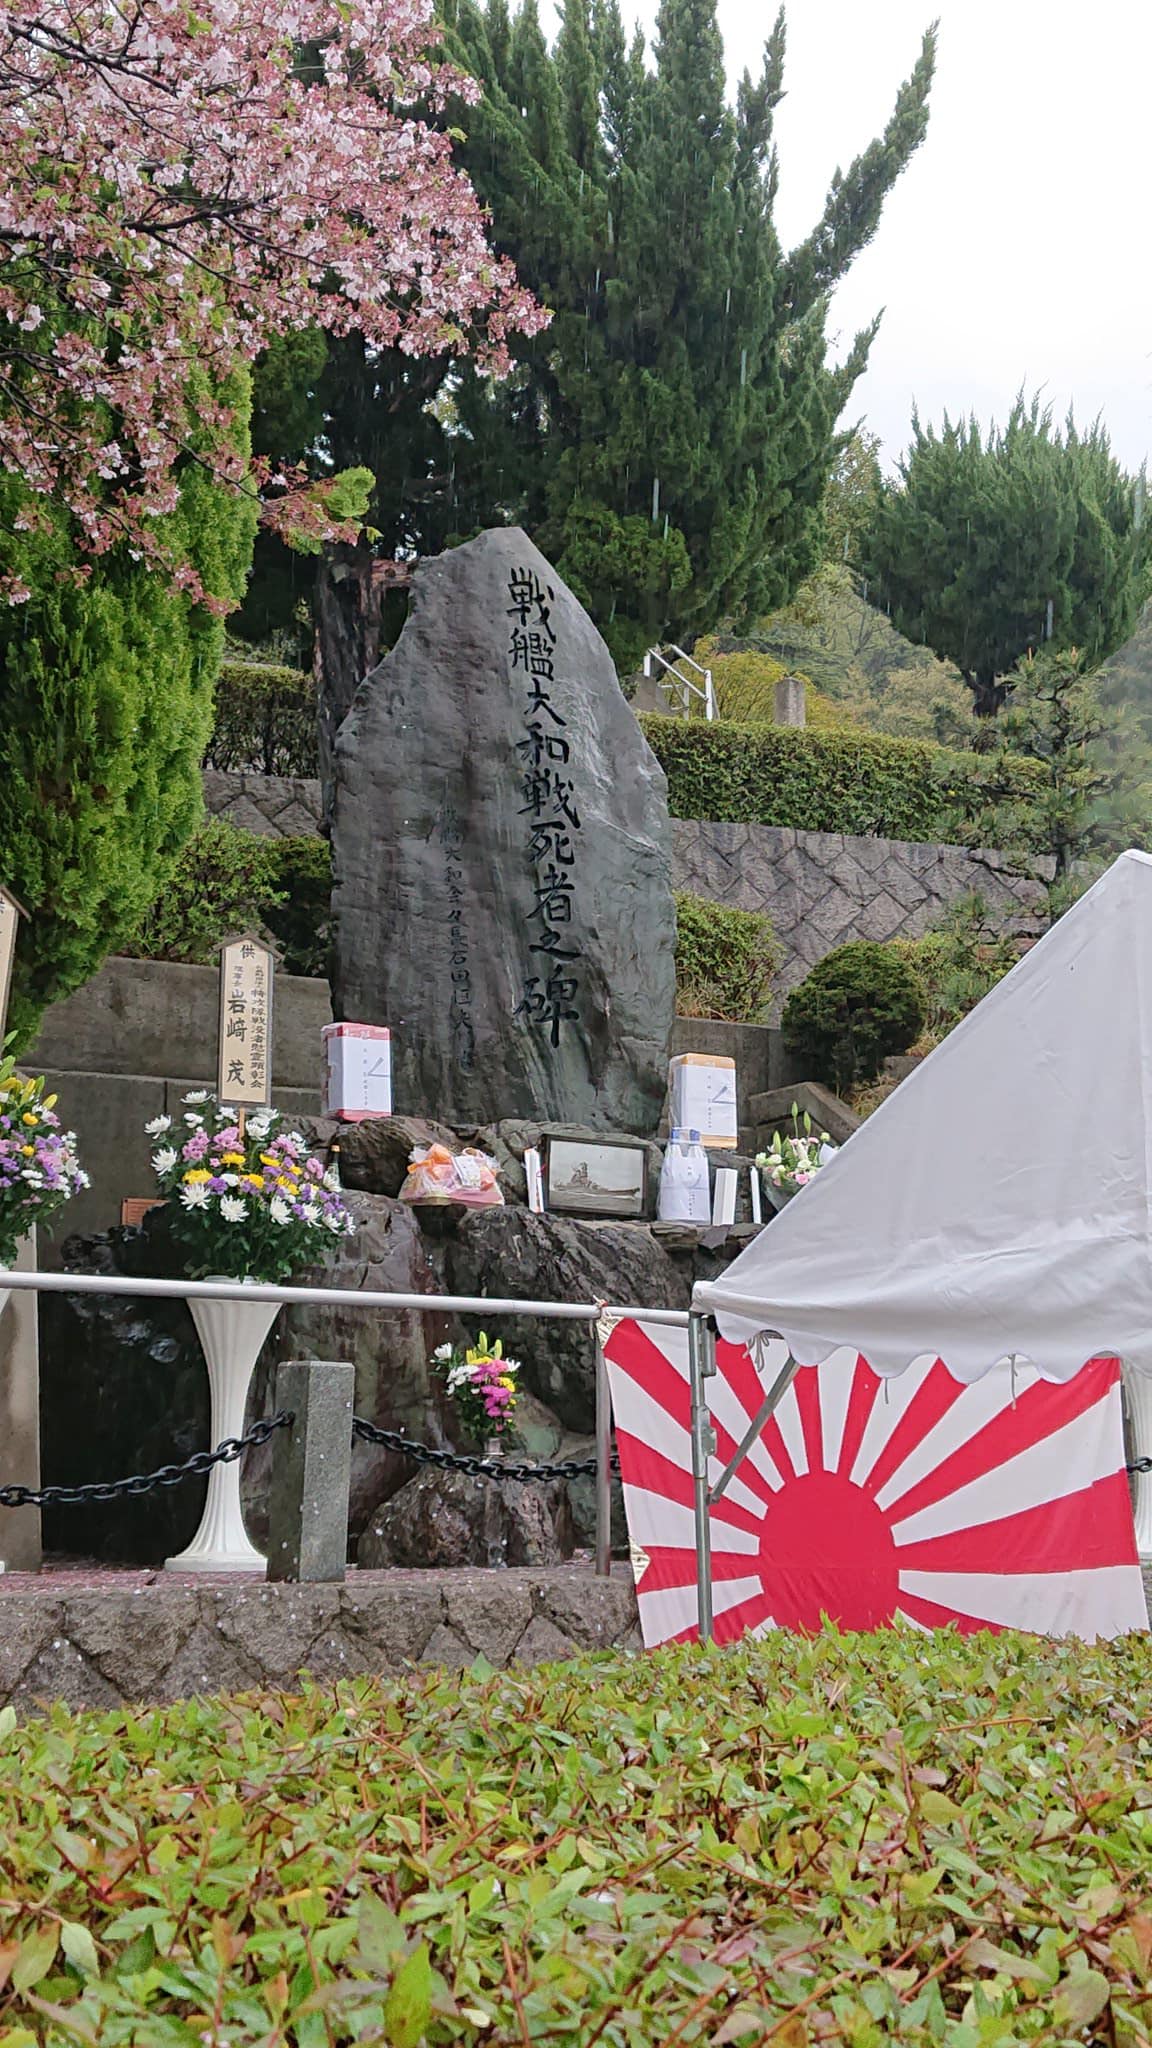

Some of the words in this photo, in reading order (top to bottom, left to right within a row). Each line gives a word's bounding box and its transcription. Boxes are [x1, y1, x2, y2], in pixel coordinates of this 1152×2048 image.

[505, 567, 582, 1049] 戦艦大和戦死者之碑
[240, 944, 256, 960] 供
[226, 1059, 245, 1087] 茂
